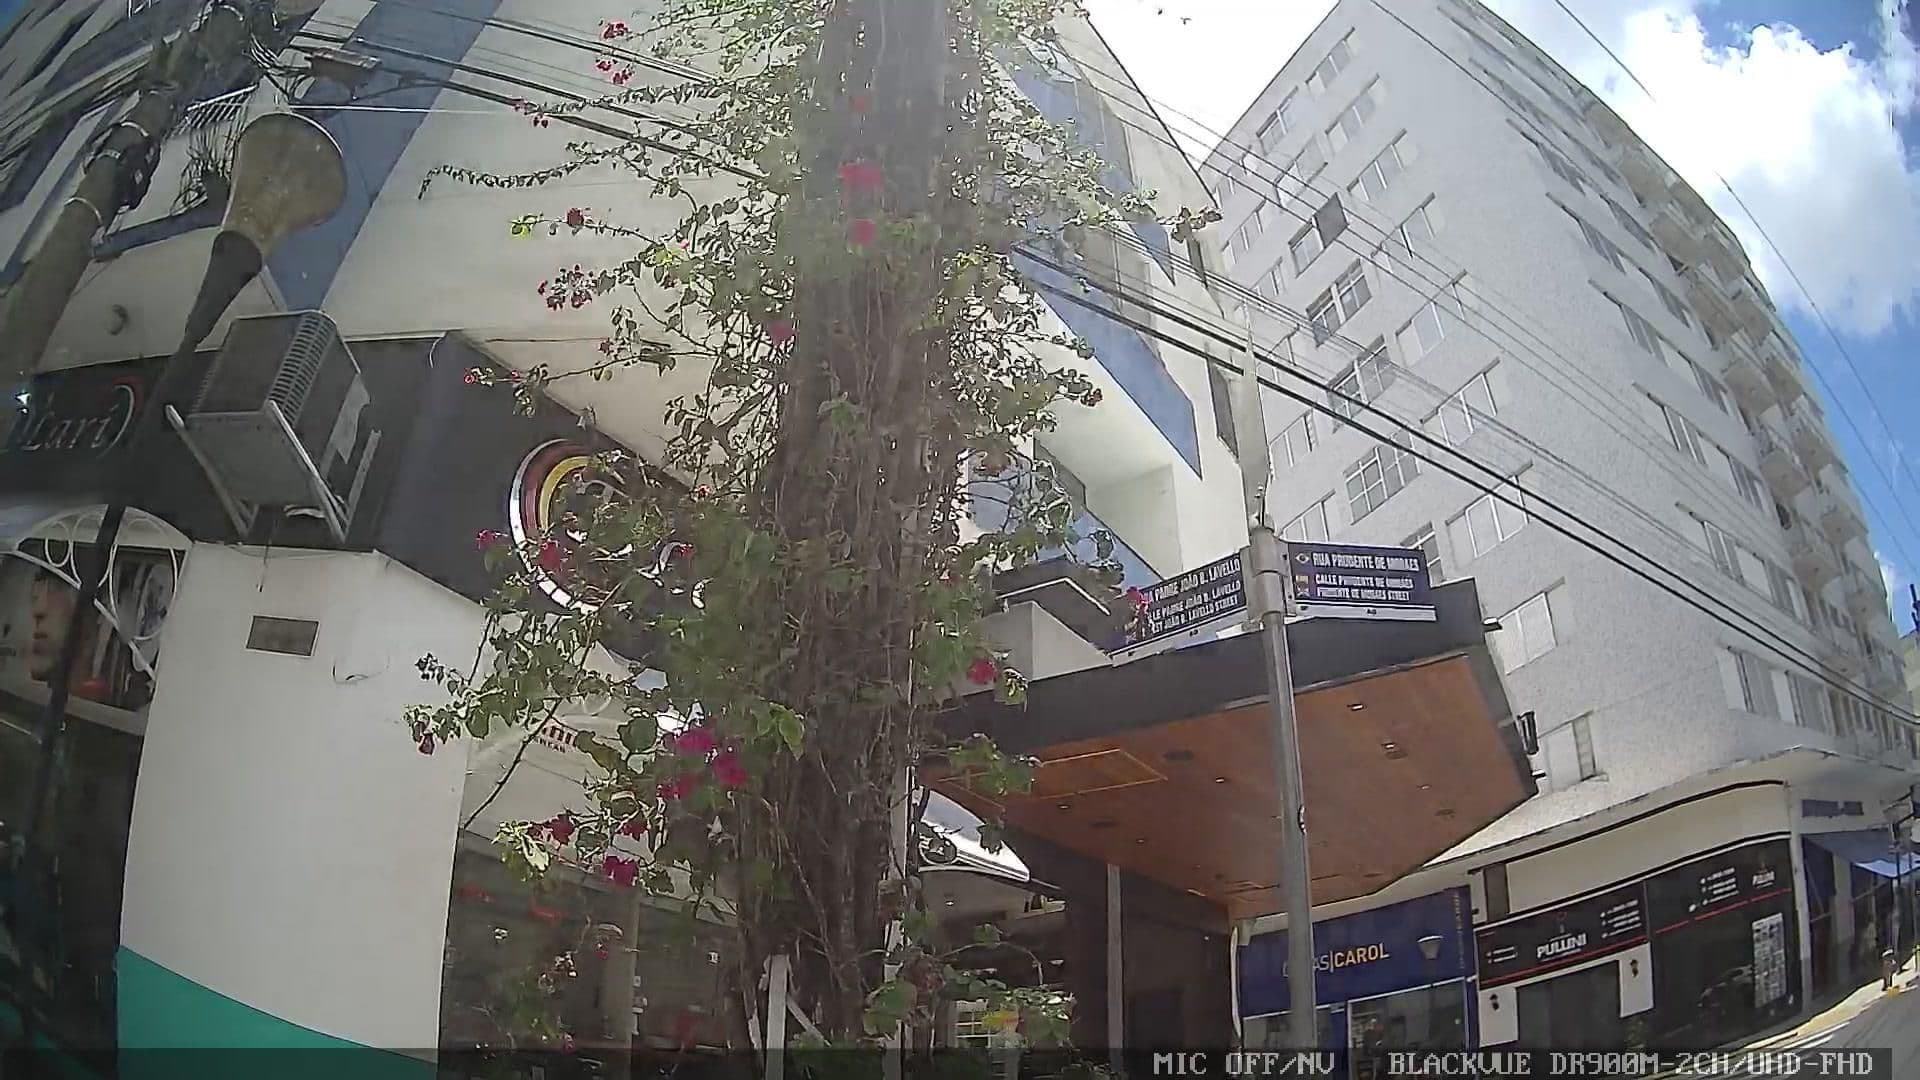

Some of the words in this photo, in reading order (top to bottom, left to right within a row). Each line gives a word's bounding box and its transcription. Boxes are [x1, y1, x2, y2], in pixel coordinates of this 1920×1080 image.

[1313, 553, 1331, 567] RUA
[1180, 573, 1198, 593] JOÃO
[1209, 558, 1240, 582] LAVELLO
[1315, 574, 1338, 586] CALLE
[1212, 579, 1241, 599] LAVELLO
[1214, 594, 1239, 612] STREET
[1334, 942, 1390, 968] CAROL
